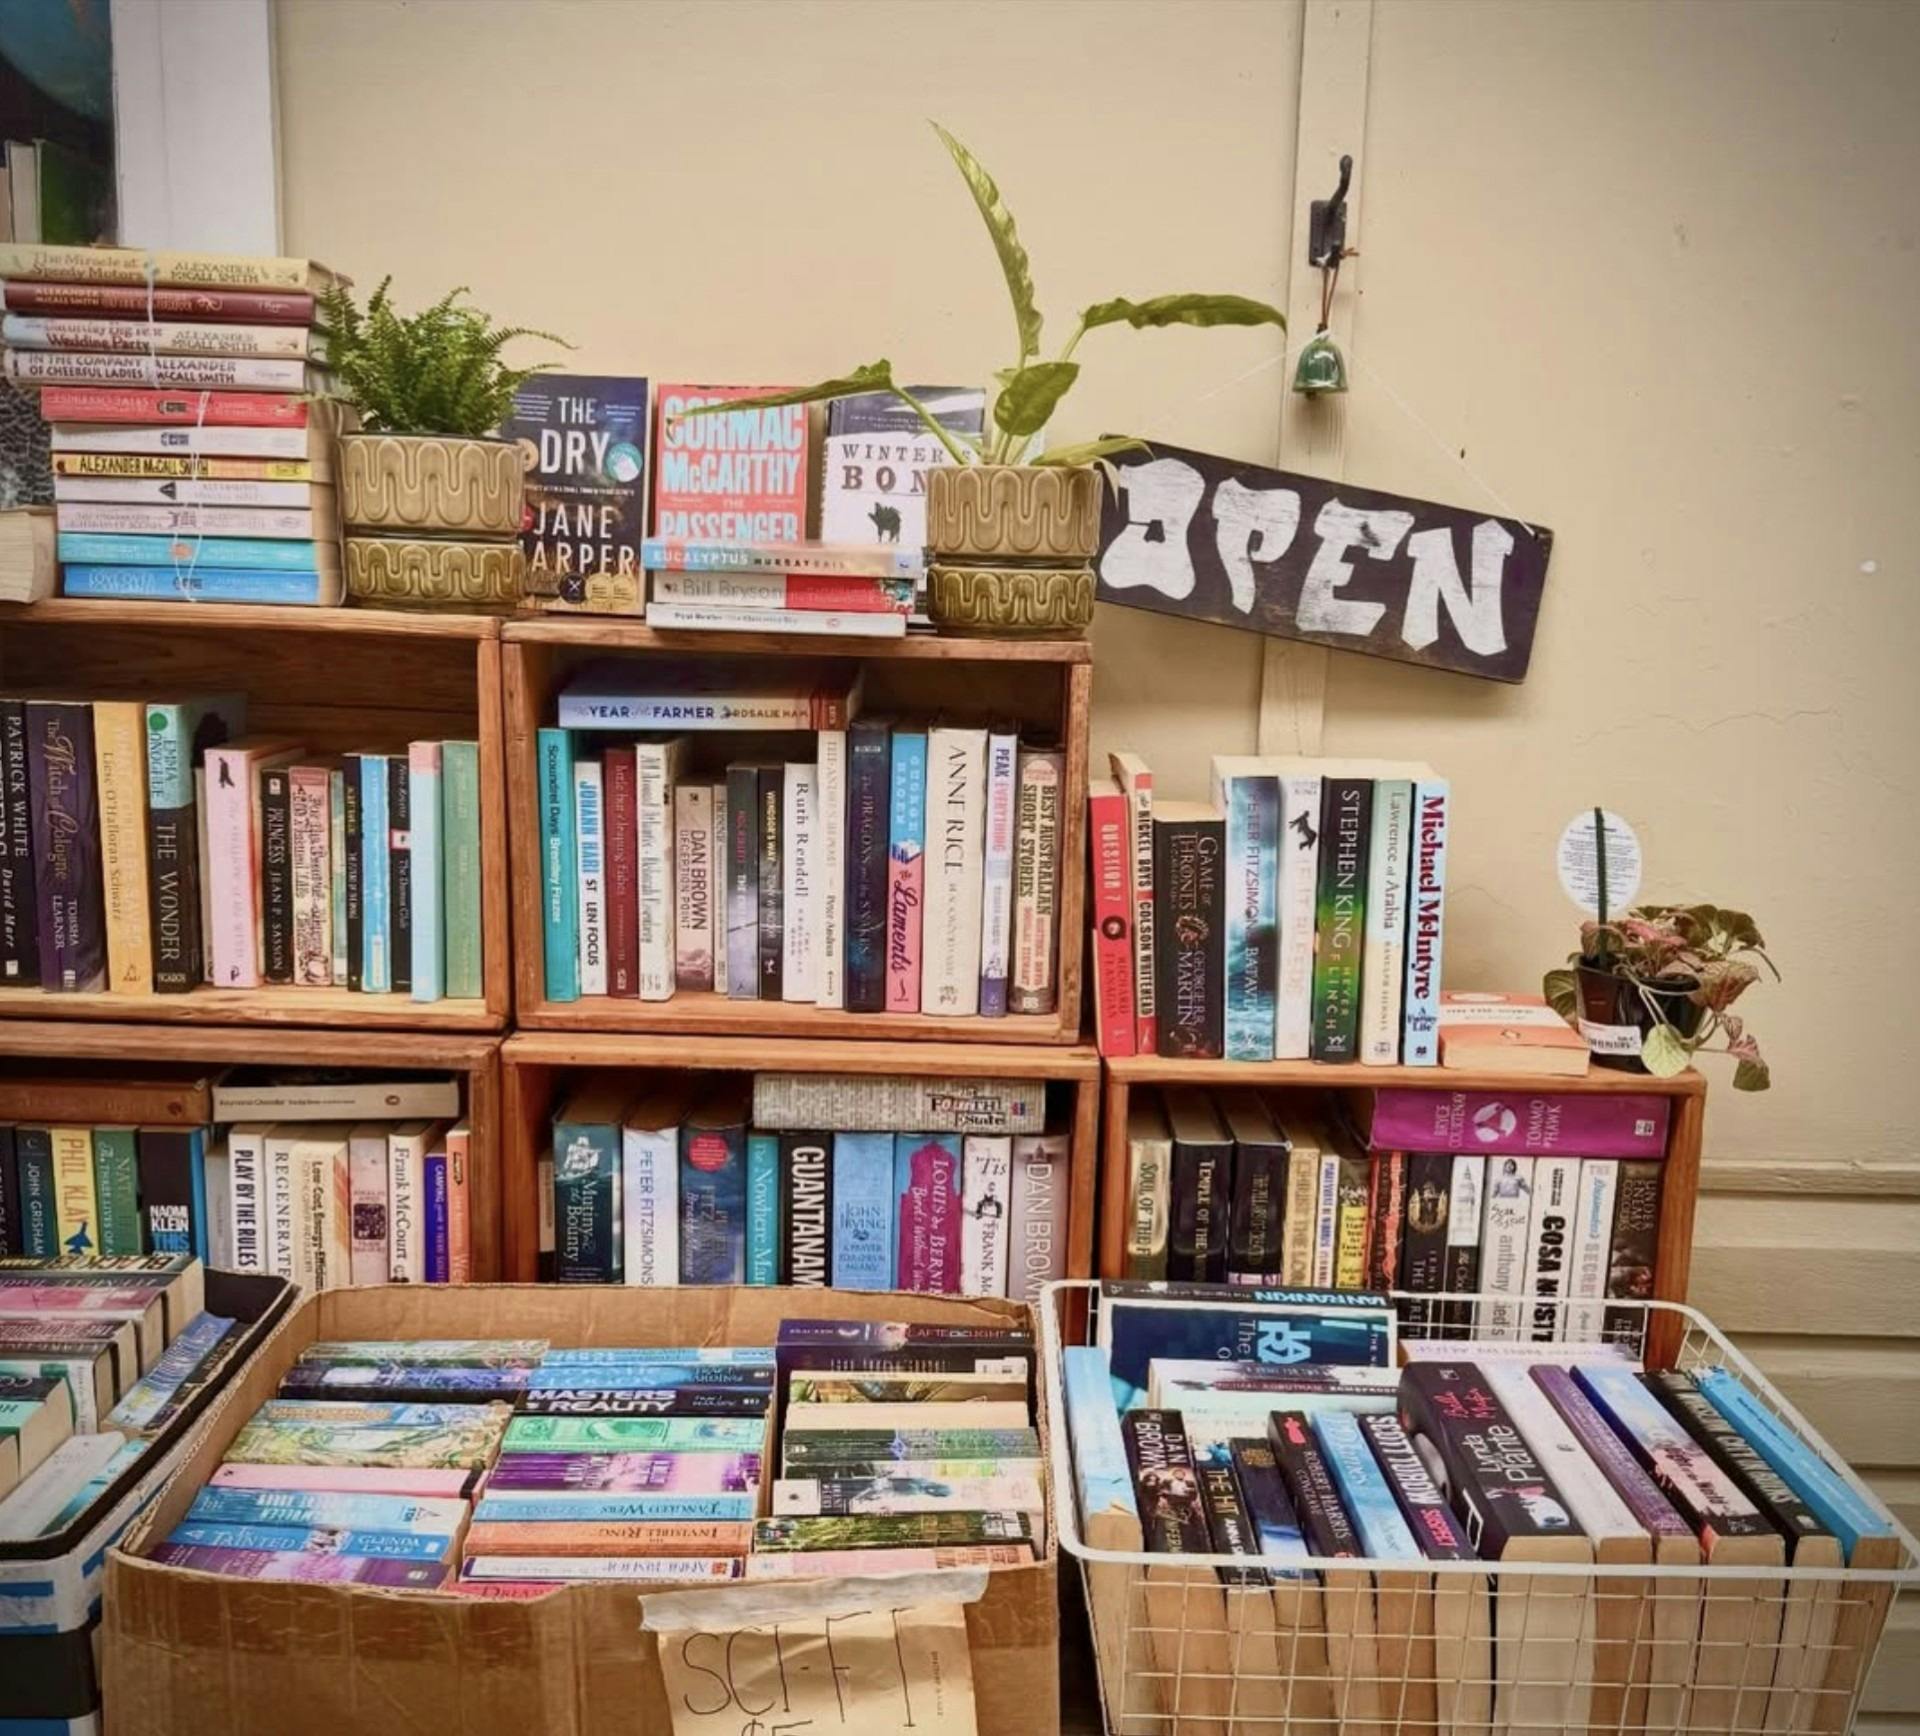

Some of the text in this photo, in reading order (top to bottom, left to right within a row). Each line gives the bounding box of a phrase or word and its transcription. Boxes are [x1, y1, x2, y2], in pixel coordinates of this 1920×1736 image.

[175, 261, 255, 274] ALEXANDER
[29, 366, 143, 379] OF CHEERFUL LADIES
[48, 355, 142, 368] THE COMPANY
[199, 372, 235, 384] SMITH
[558, 397, 596, 425] THE
[664, 396, 803, 450] CORMAC
[80, 457, 141, 474] ALEXANDER
[540, 429, 611, 475] DRY
[664, 451, 800, 495] McCARTHY
[841, 465, 928, 493] BON
[534, 502, 613, 538] JANE
[660, 511, 797, 542] PASSENGER
[520, 539, 635, 576] ARPER
[654, 551, 810, 568] EUCALYPTUS MURRAY
[1100, 457, 1515, 656] OPEN
[683, 578, 716, 597] Bill
[719, 580, 783, 601] Bryson
[590, 706, 809, 719] YEAR FARMER ROSALIE HAM
[8, 716, 27, 857] PATRICK WHITE
[164, 740, 177, 782] EMMA
[547, 745, 559, 804] Scoundrel
[947, 745, 966, 814] ANNE
[42, 736, 78, 880] Witch Cologne
[549, 807, 561, 834] Days
[766, 791, 776, 840] WINDSOR'S
[795, 783, 809, 824] Ruth
[992, 748, 1010, 852] PEAK EVERYTHING
[1246, 794, 1260, 840] PETER
[767, 842, 776, 862] WAY
[794, 833, 809, 897] Rendell
[944, 820, 965, 875] RICE
[1020, 784, 1036, 897] SHORT STORIES
[1037, 785, 1056, 915] BEST AUSTRALIAN
[1101, 823, 1120, 888] QUESTION
[1197, 837, 1218, 890] GAME
[1382, 791, 1405, 930] Lawrence Arabia
[1, 868, 13, 912] David
[156, 823, 181, 961] THE WONDER
[268, 807, 284, 971] PRINCESS JEAN SASSON
[580, 781, 600, 966] JOHANN HARI FOCUS
[680, 830, 691, 929] DECEPTION POINT
[691, 830, 707, 930] DAN BROWN
[1177, 833, 1197, 910] THRONES
[1331, 790, 1360, 948] STEPHEN KING
[52, 895, 64, 950] LEARNER
[825, 895, 837, 920] Peter
[1137, 811, 1153, 1016] NICKEL BOYS COLSON WHITEHEAD
[1411, 795, 1445, 999] Michael McIntyre
[2, 915, 17, 948] Marr
[891, 880, 918, 974] Laments
[1104, 953, 1116, 1019] FLANAGAN
[1116, 955, 1128, 1014] RICHARD
[1177, 951, 1194, 1026] MARTIN
[1433, 1103, 1450, 1138] BRYCE
[1449, 1092, 1467, 1149] COURTENAY
[1526, 1099, 1545, 1149] TOMMO
[1545, 1103, 1562, 1141] HAWK
[60, 1138, 90, 1223] PHIL KLAY
[395, 1147, 411, 1259] Frank McCourt
[433, 1164, 445, 1203] CAMPING
[752, 1144, 774, 1243] The Nowhere
[911, 1186, 927, 1223] Birds
[932, 1159, 949, 1214] LOUIS
[1026, 1163, 1052, 1214] DAN
[1136, 1162, 1159, 1245] SOUL OF THE
[1195, 1159, 1216, 1250] TEMPLE THE
[1629, 1179, 1644, 1232] ENEMY
[1641, 1180, 1657, 1231] UNDER
[27, 1162, 44, 1255] JOHN GRISHAM
[150, 1205, 189, 1217] NAOMI
[150, 1217, 189, 1232] KLEIN
[234, 1150, 258, 1268] PLAY BY THE RULES
[562, 1206, 582, 1262] Bounty
[576, 1178, 598, 1237] Mutiny
[640, 1150, 655, 1285] PETER FITZSIMONS
[791, 1146, 826, 1287] GUANTANAM
[840, 1218, 886, 1231] IRVING
[846, 1205, 881, 1217] JOHN
[103, 1230, 113, 1245] OF
[152, 1233, 190, 1250] THIS
[980, 1221, 998, 1272] FRANK
[1490, 1234, 1515, 1292] anthony
[1537, 1215, 1566, 1273] COSA
[1411, 1259, 1426, 1286] THE
[1237, 1320, 1257, 1353] The
[527, 1390, 677, 1401] MASTERS
[1133, 1421, 1168, 1478] BROWN
[1165, 1433, 1188, 1464] DAN
[1462, 1434, 1503, 1472] Lynda
[1488, 1425, 1544, 1481] Plante
[1205, 1469, 1240, 1516] THE HIT
[1302, 1449, 1350, 1540] ROBERT HARRIS
[1367, 1414, 1458, 1549] SCOTT TUROW SUSPECT
